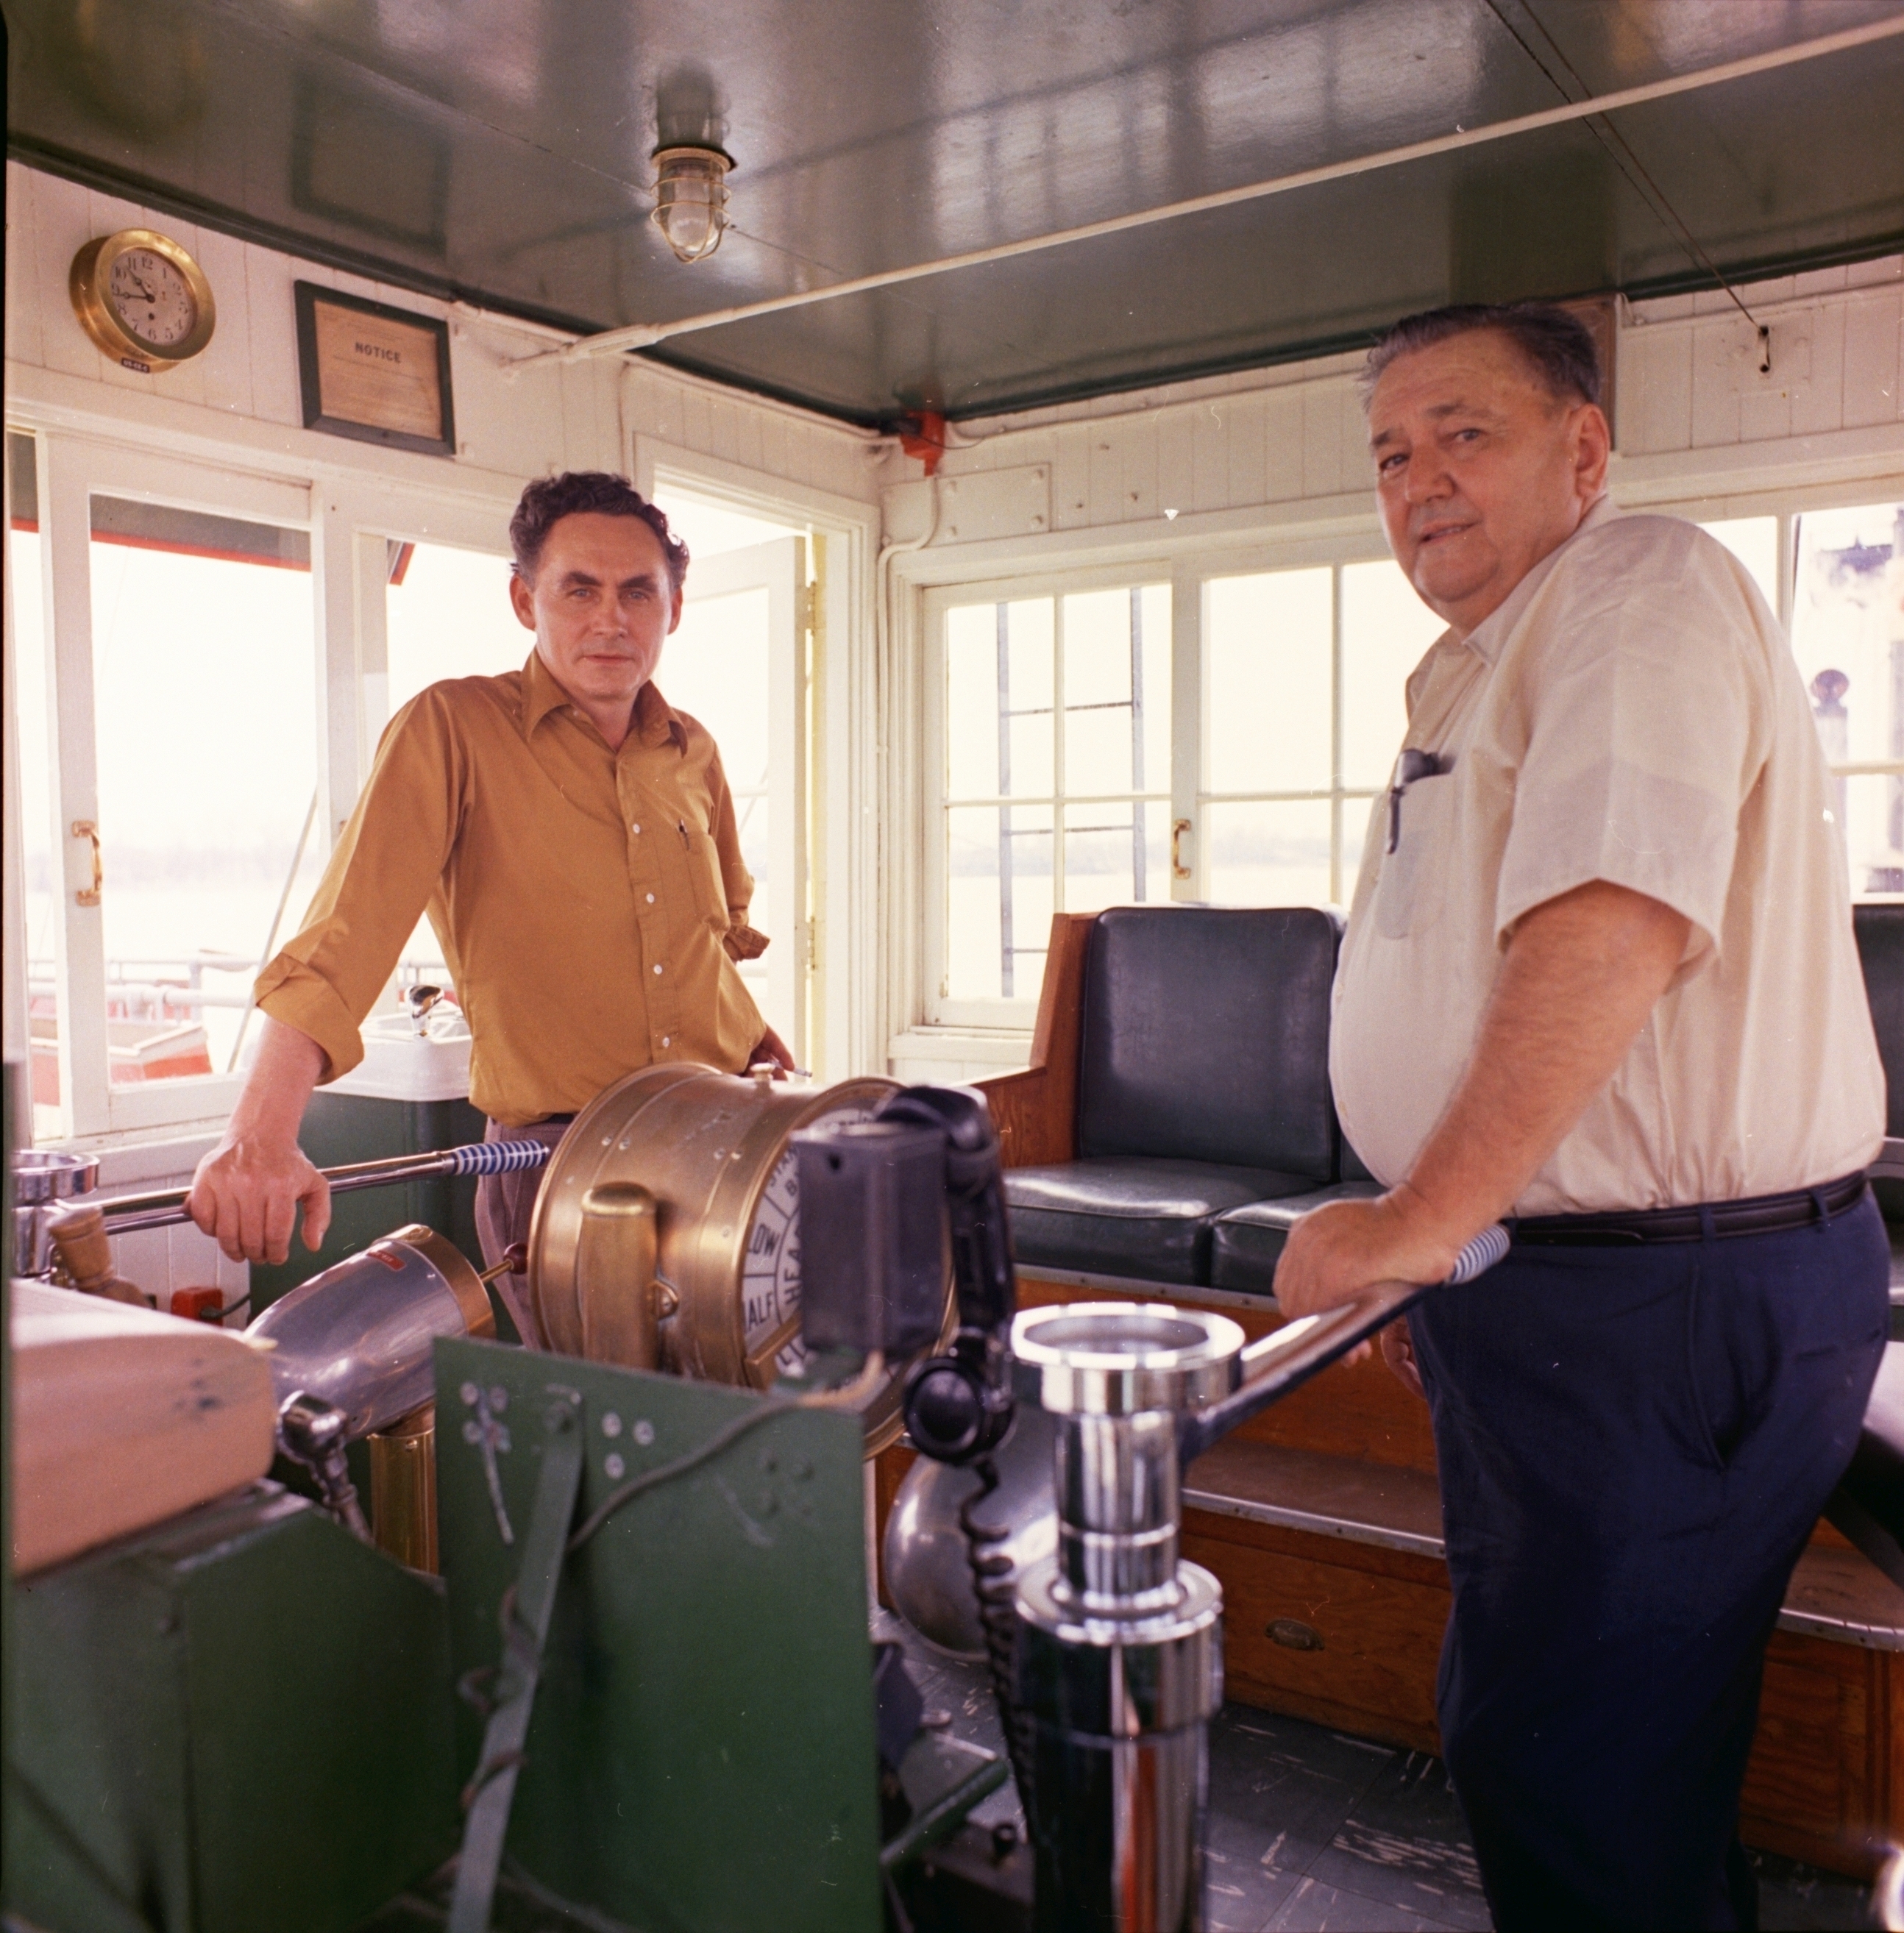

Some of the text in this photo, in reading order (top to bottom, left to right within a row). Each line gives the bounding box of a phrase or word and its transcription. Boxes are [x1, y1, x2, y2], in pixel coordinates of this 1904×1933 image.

[128, 257, 137, 271] 11
[142, 256, 153, 271] 12
[116, 266, 127, 280] 10
[163, 267, 167, 279] 1
[172, 282, 182, 296] 2
[118, 302, 127, 316] 8
[180, 301, 189, 315] 3
[132, 317, 139, 332] 7
[174, 318, 182, 330] 4
[149, 329, 157, 341] 6
[165, 327, 174, 340] 5
[355, 341, 402, 364] NOTICE
[747, 1222, 780, 1257] OW
[745, 1292, 772, 1331] ALF
